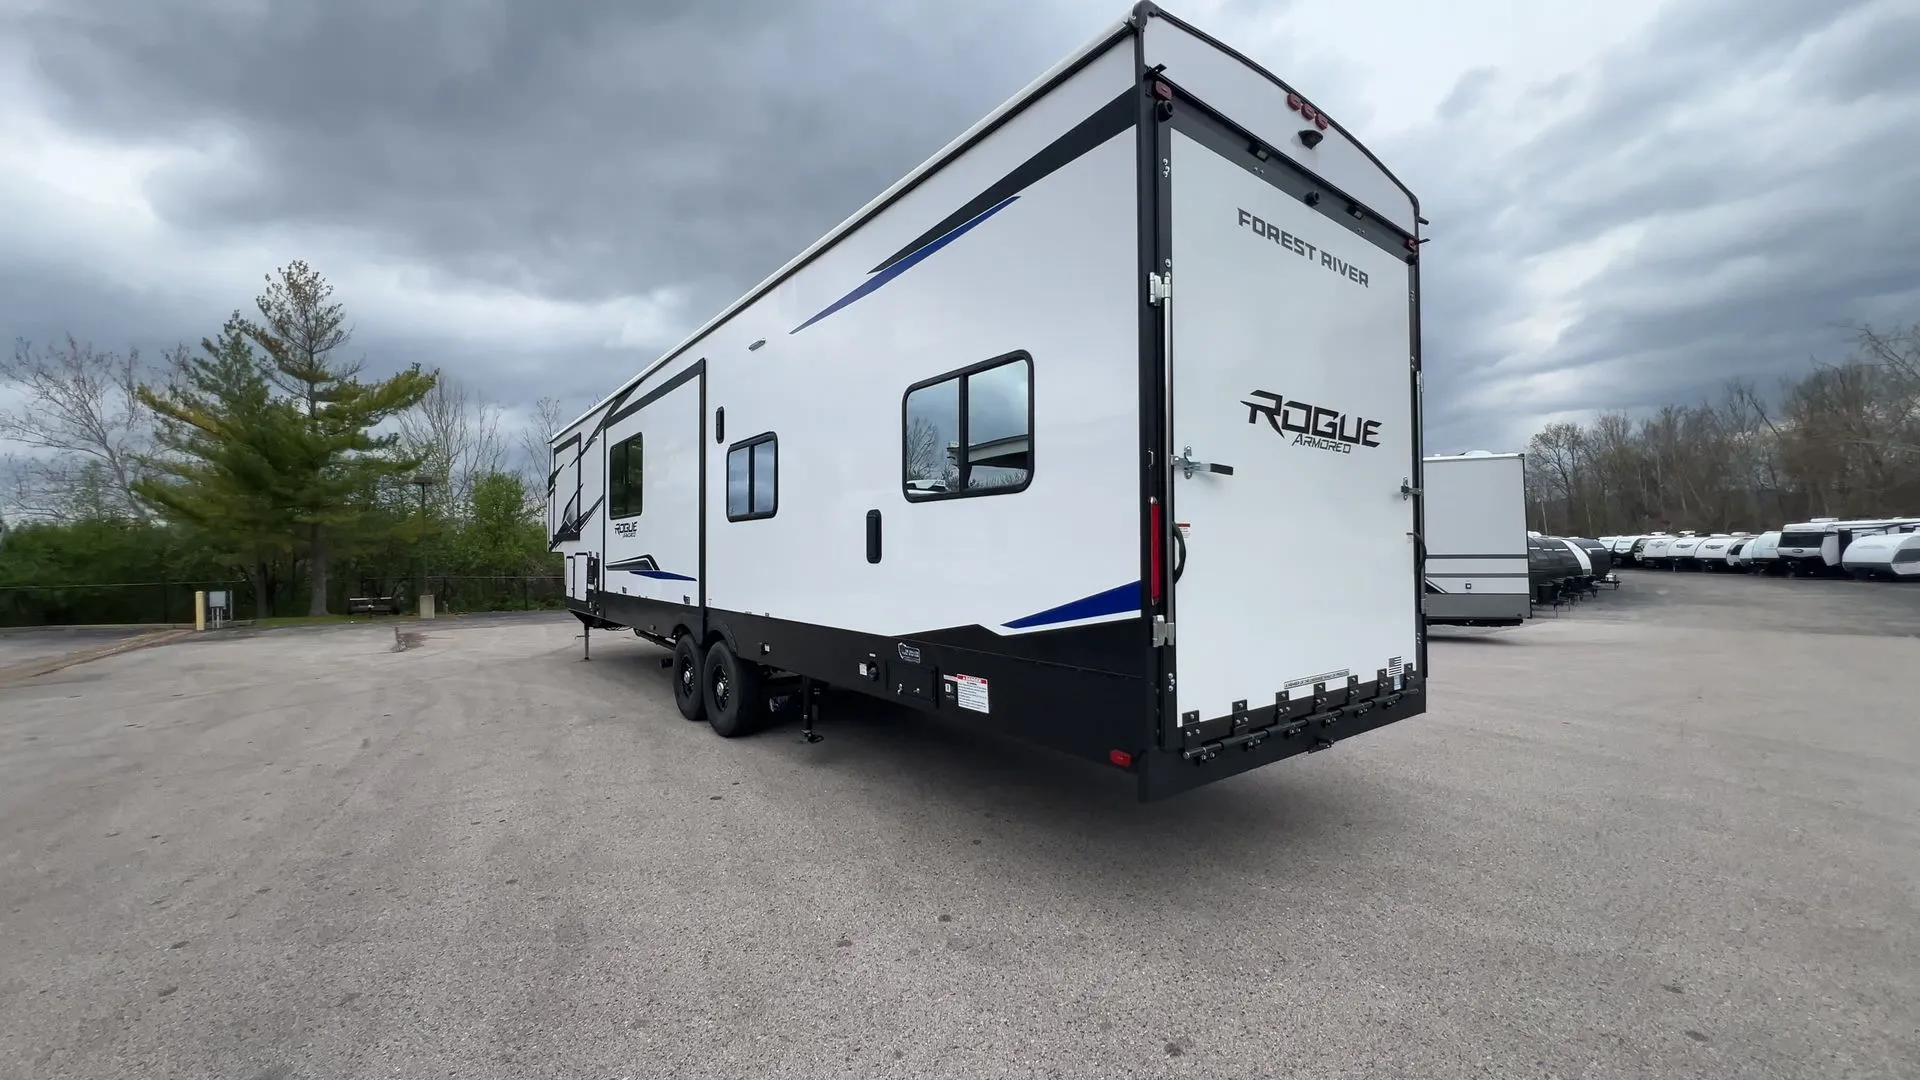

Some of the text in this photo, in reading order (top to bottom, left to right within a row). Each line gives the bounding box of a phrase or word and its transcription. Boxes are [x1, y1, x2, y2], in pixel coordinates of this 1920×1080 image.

[1237, 208, 1369, 288] FOREST RIVER
[1240, 389, 1383, 448] ROGUE
[1291, 433, 1352, 454] ARMORED
[614, 521, 638, 535] ROGUE
